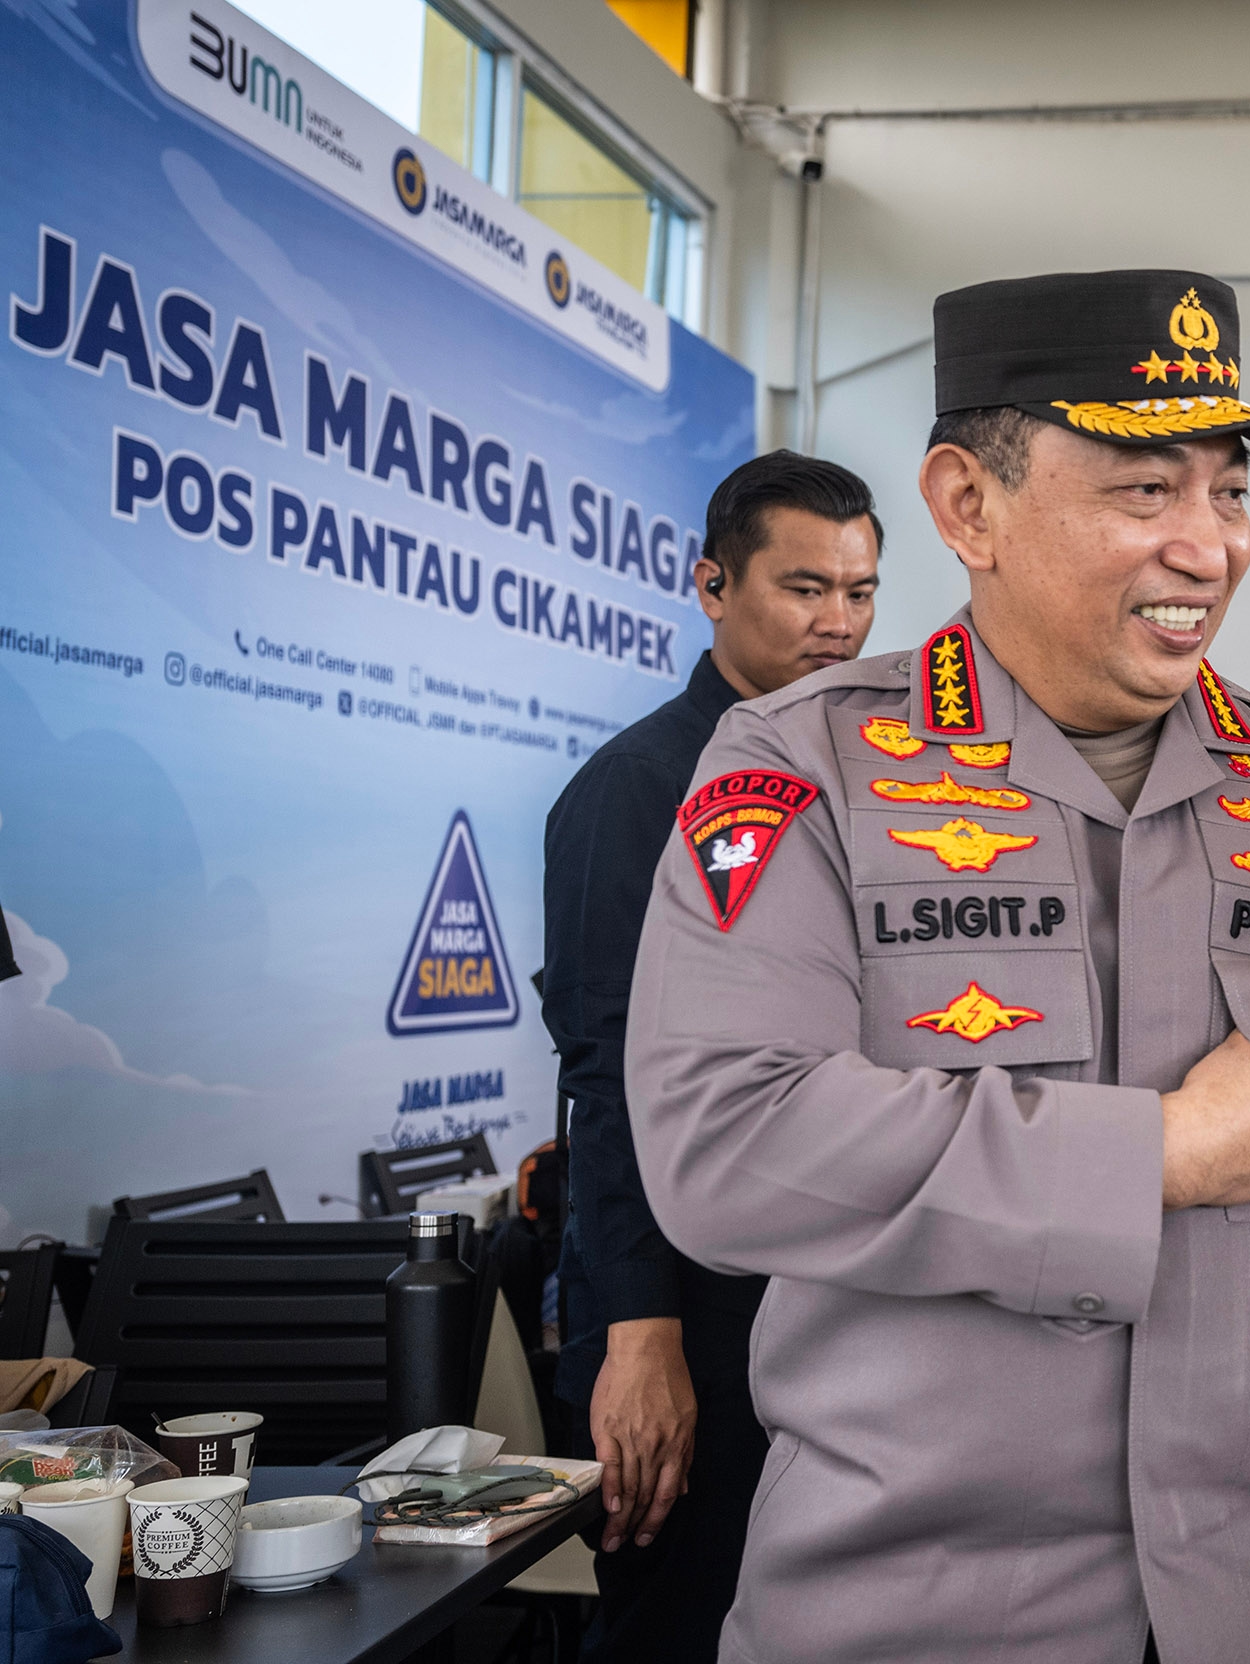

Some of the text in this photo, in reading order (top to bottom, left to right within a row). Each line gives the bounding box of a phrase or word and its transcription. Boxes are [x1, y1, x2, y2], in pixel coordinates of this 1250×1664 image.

[433, 184, 527, 267] JASAMARGA
[12, 229, 699, 597] JASA MARGA SIAGA
[116, 433, 678, 674] POS PANTAU CIKAMPEK
[256, 637, 284, 659] One
[288, 643, 312, 666] Call
[316, 651, 357, 676] Center
[190, 664, 322, 710] @official.jasamarga
[425, 675, 458, 697] Mobile
[685, 775, 802, 820] PELOPOR
[693, 808, 785, 845] KORPS BRIMOB
[440, 900, 478, 926] JASA
[874, 896, 1066, 943] L.SIGIT.P
[431, 928, 486, 954] MARGA
[418, 957, 496, 999] SIAGA
[398, 1076, 442, 1113] JASA
[146, 1532, 191, 1543] PREMIUM
[147, 1541, 189, 1550] COFFEE
